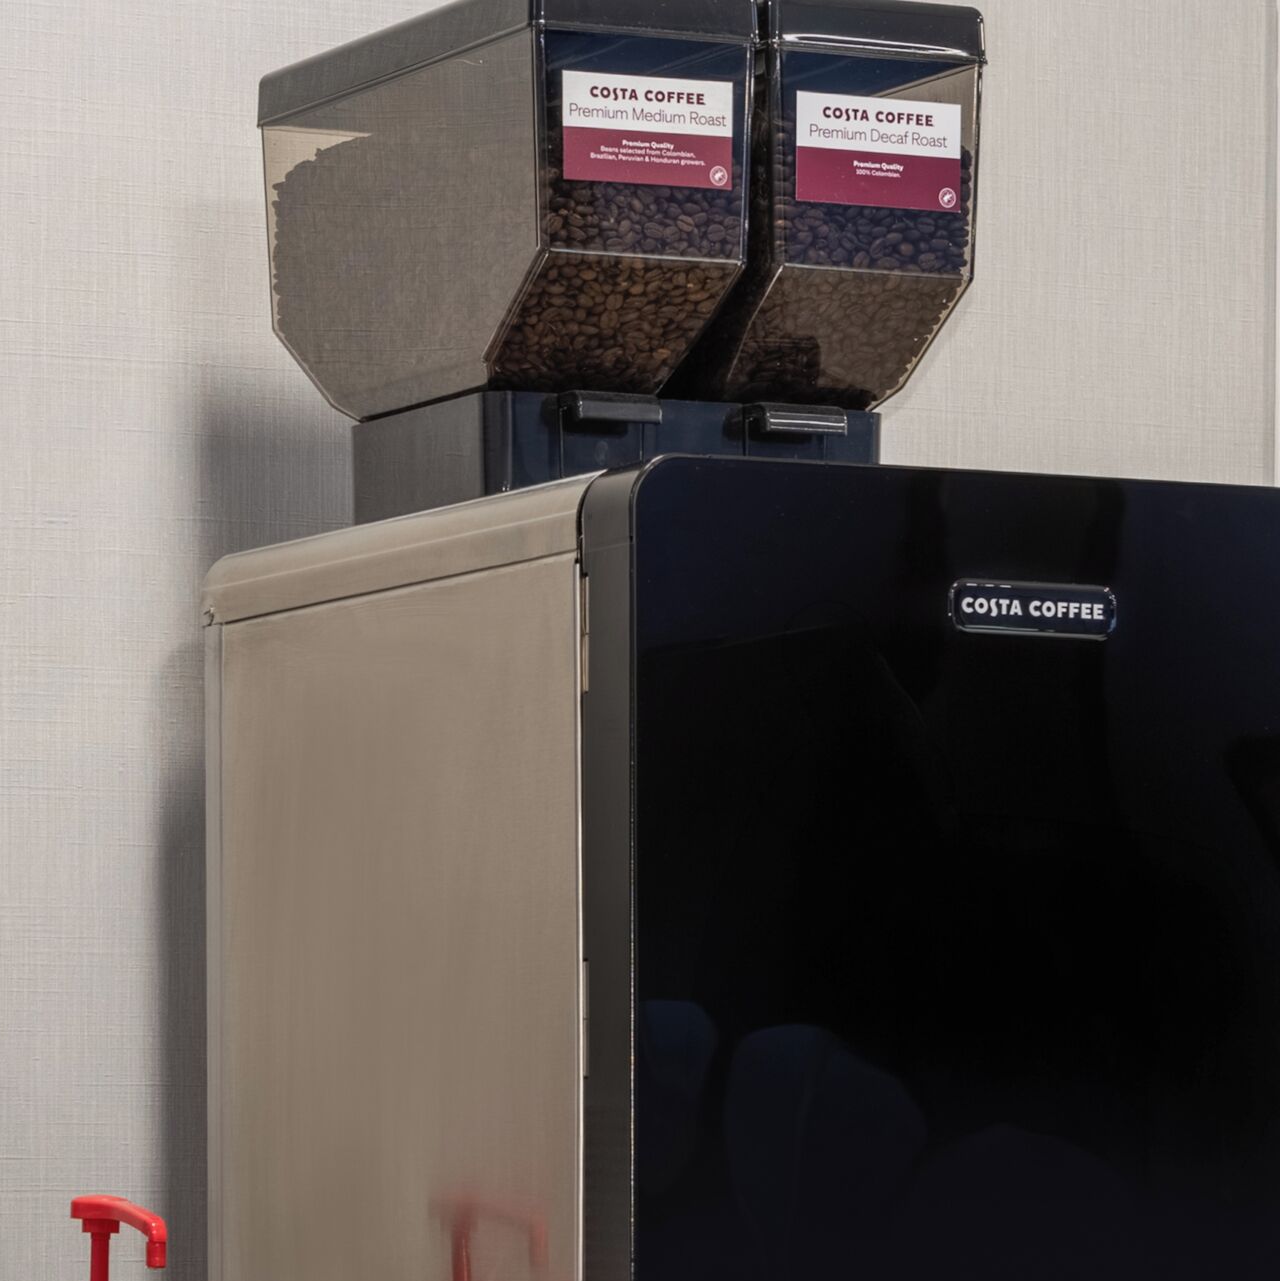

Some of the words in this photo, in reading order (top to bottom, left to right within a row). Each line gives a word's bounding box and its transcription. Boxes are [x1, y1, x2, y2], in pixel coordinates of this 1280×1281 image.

[590, 85, 638, 101] COSTA
[644, 90, 705, 105] COFFEE
[569, 103, 629, 120] Premium
[632, 108, 686, 124] Medium
[689, 112, 727, 127] Roast
[823, 106, 869, 121] COSTA
[875, 111, 933, 127] COFFEE
[622, 140, 650, 148] Premium
[651, 142, 674, 150] Quality
[809, 123, 867, 141] Premium
[870, 129, 908, 144] Decaf
[911, 132, 948, 148] Roast
[853, 160, 880, 168] Premium
[881, 163, 904, 172] Quality
[961, 597, 1023, 617] COSTA
[1029, 600, 1105, 620] COFFEE
